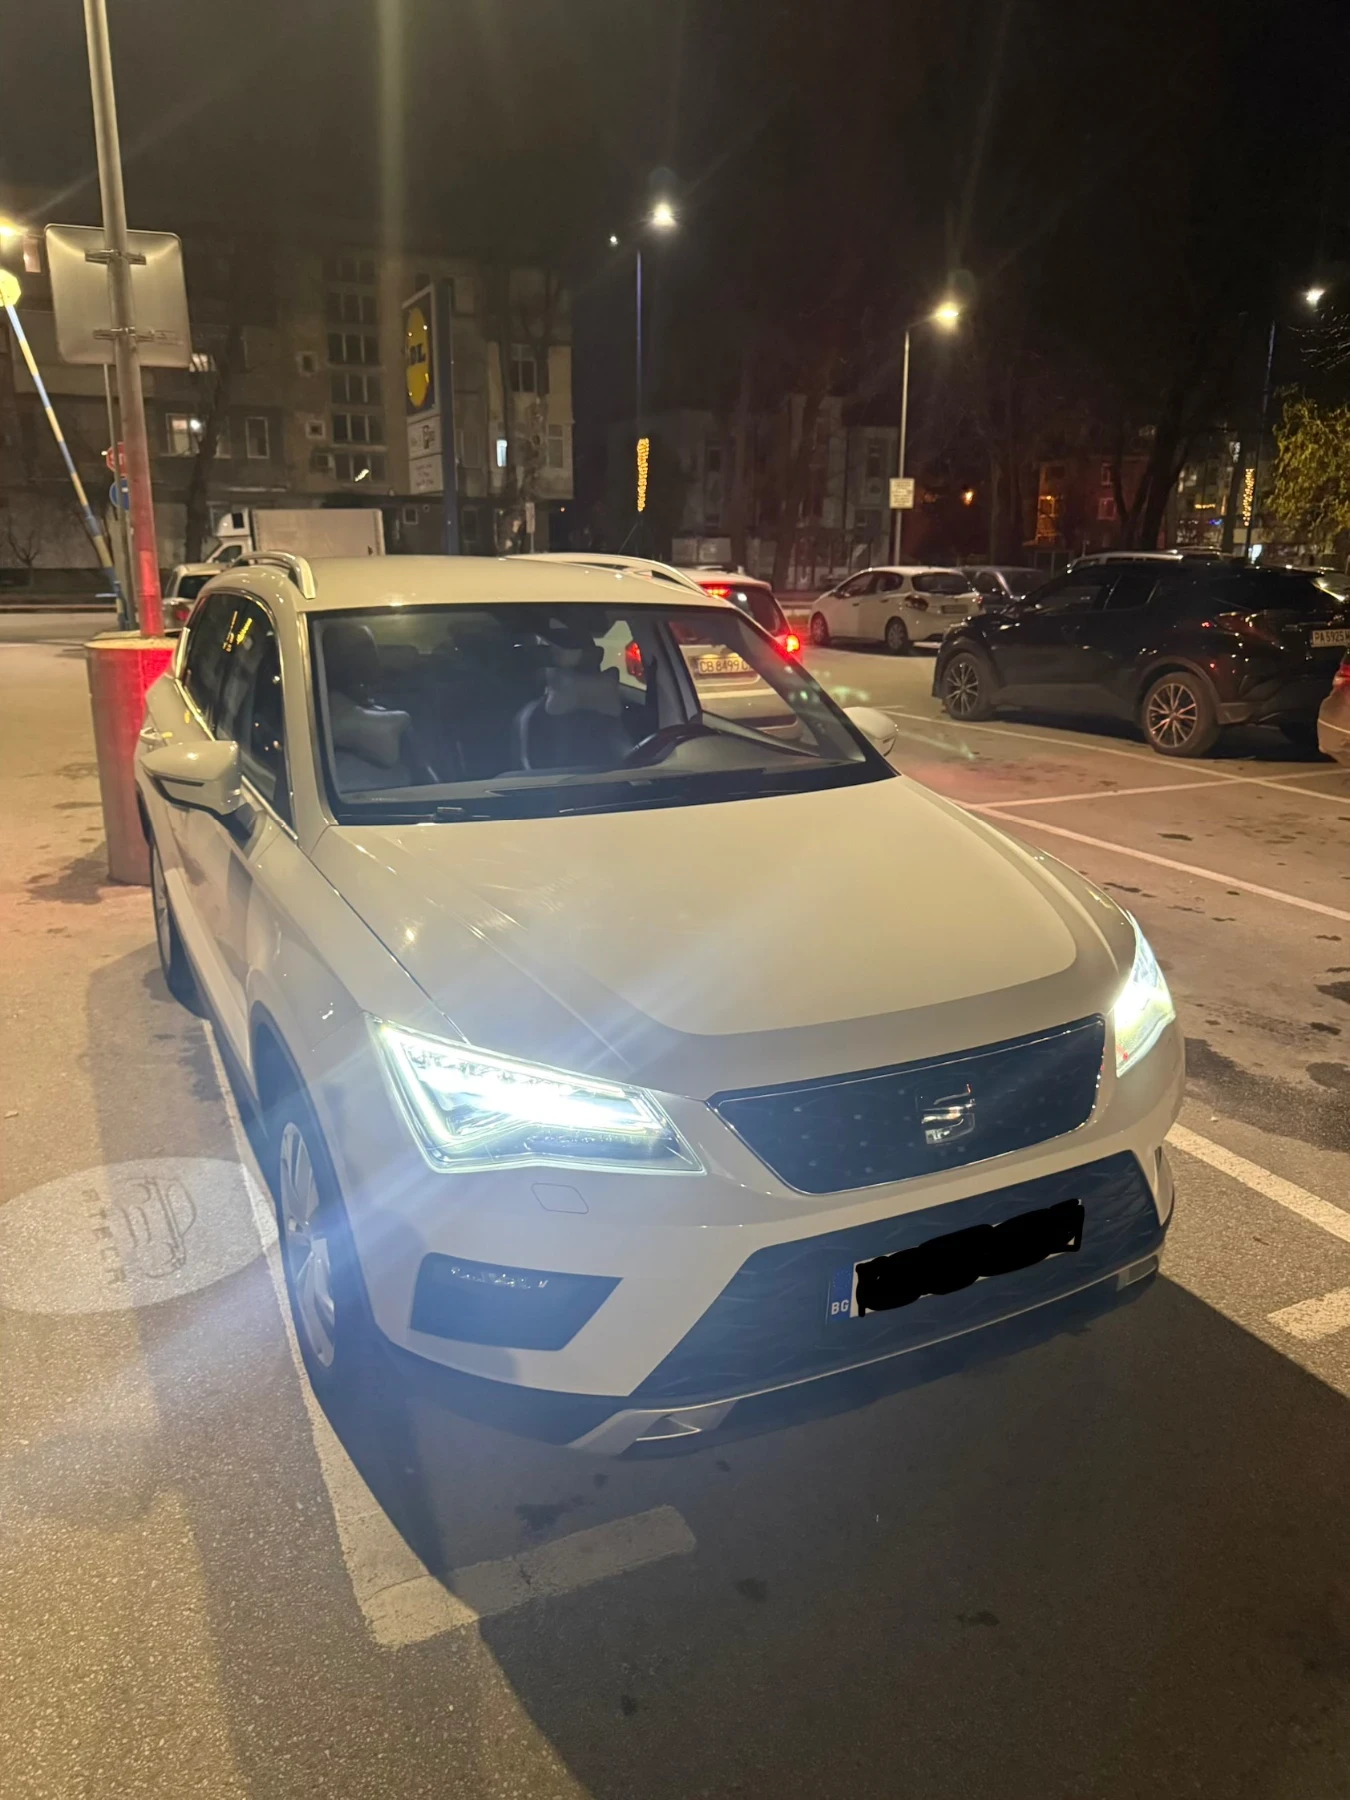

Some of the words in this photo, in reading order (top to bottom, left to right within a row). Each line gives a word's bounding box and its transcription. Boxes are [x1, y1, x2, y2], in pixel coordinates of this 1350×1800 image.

[1314, 631, 1324, 642] PA
[700, 661, 714, 673] CB
[716, 660, 740, 671] 8499
[831, 1299, 849, 1315] BG
